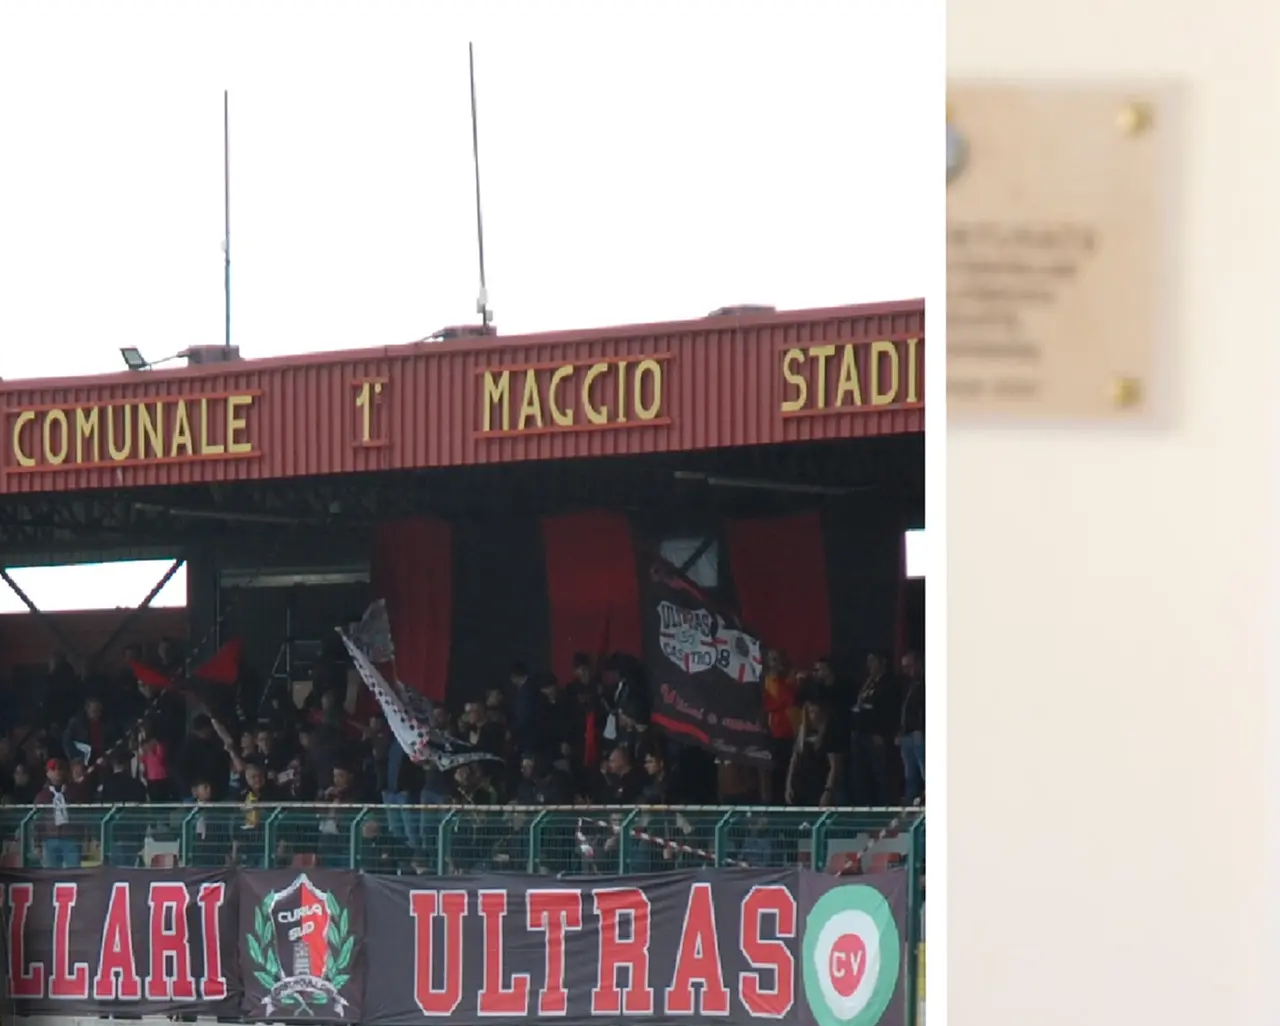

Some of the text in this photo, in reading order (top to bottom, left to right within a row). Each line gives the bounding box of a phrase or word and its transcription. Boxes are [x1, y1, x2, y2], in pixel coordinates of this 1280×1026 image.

[13, 396, 253, 467] COMUNALE
[482, 358, 663, 432] MAGGIO
[781, 338, 918, 412] STADI
[409, 882, 797, 1018] ULTRAS
[831, 949, 863, 978] CV
